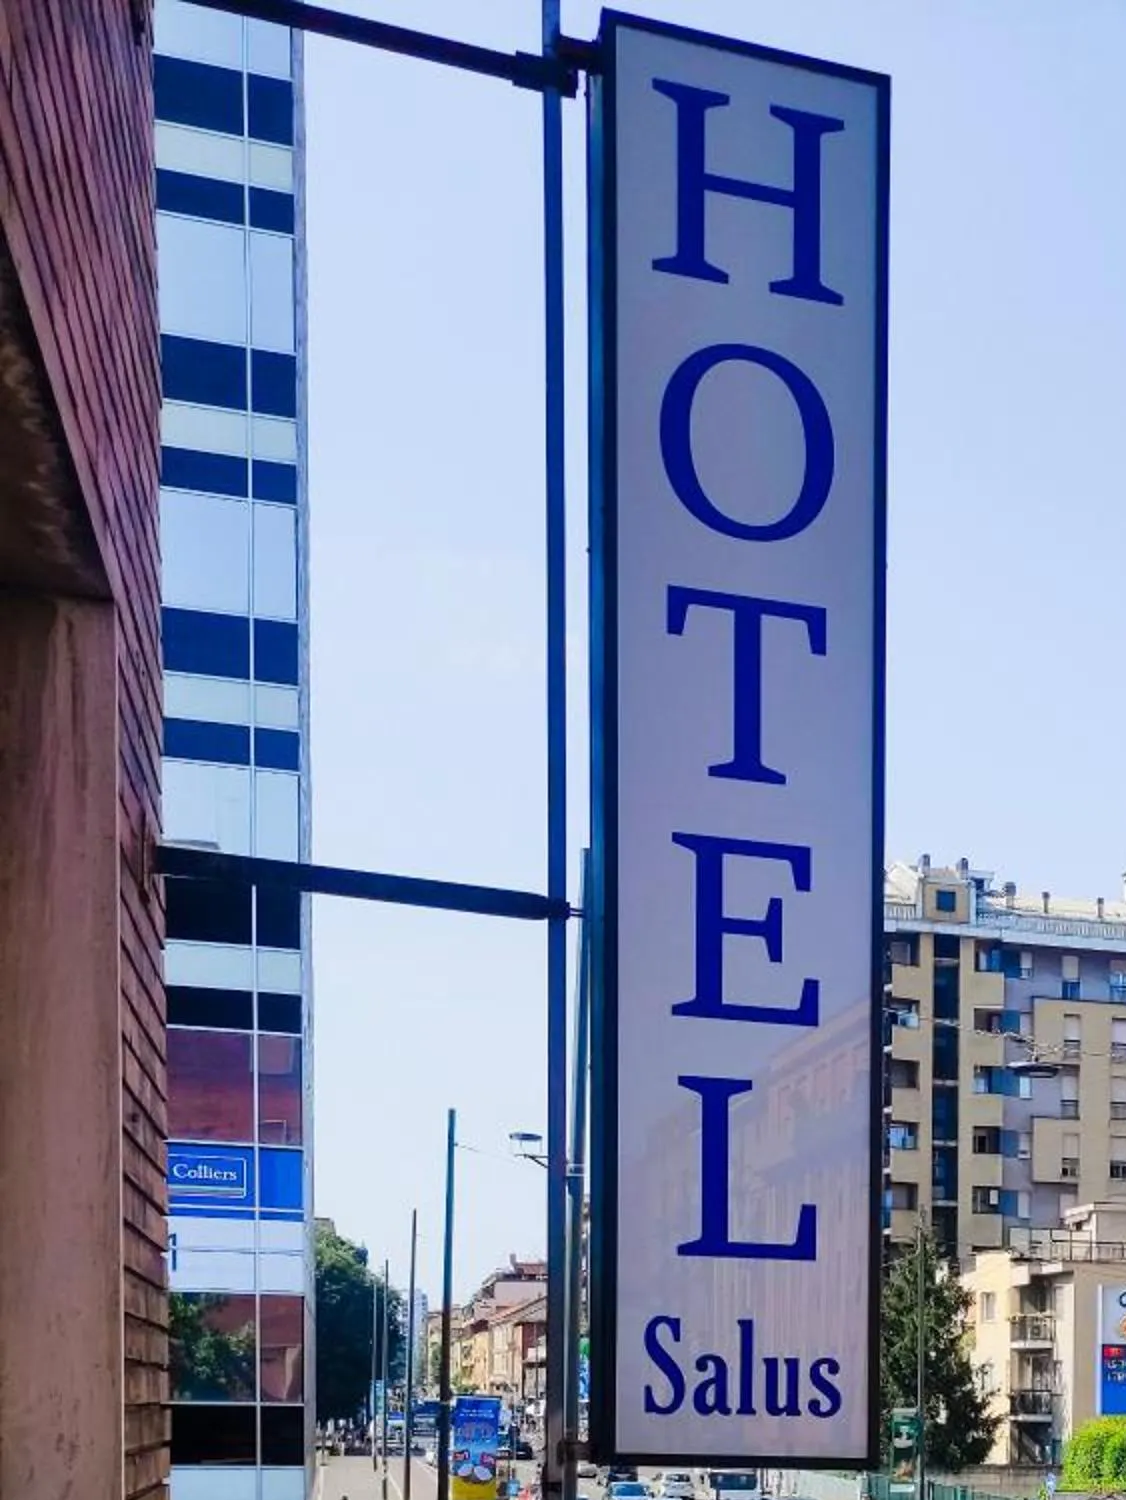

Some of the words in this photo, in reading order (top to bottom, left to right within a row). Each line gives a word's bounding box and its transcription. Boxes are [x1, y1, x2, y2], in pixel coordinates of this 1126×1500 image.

[652, 77, 845, 1262] HOTEL
[172, 1163, 237, 1181] Colliers
[643, 1315, 842, 1419] Salus
